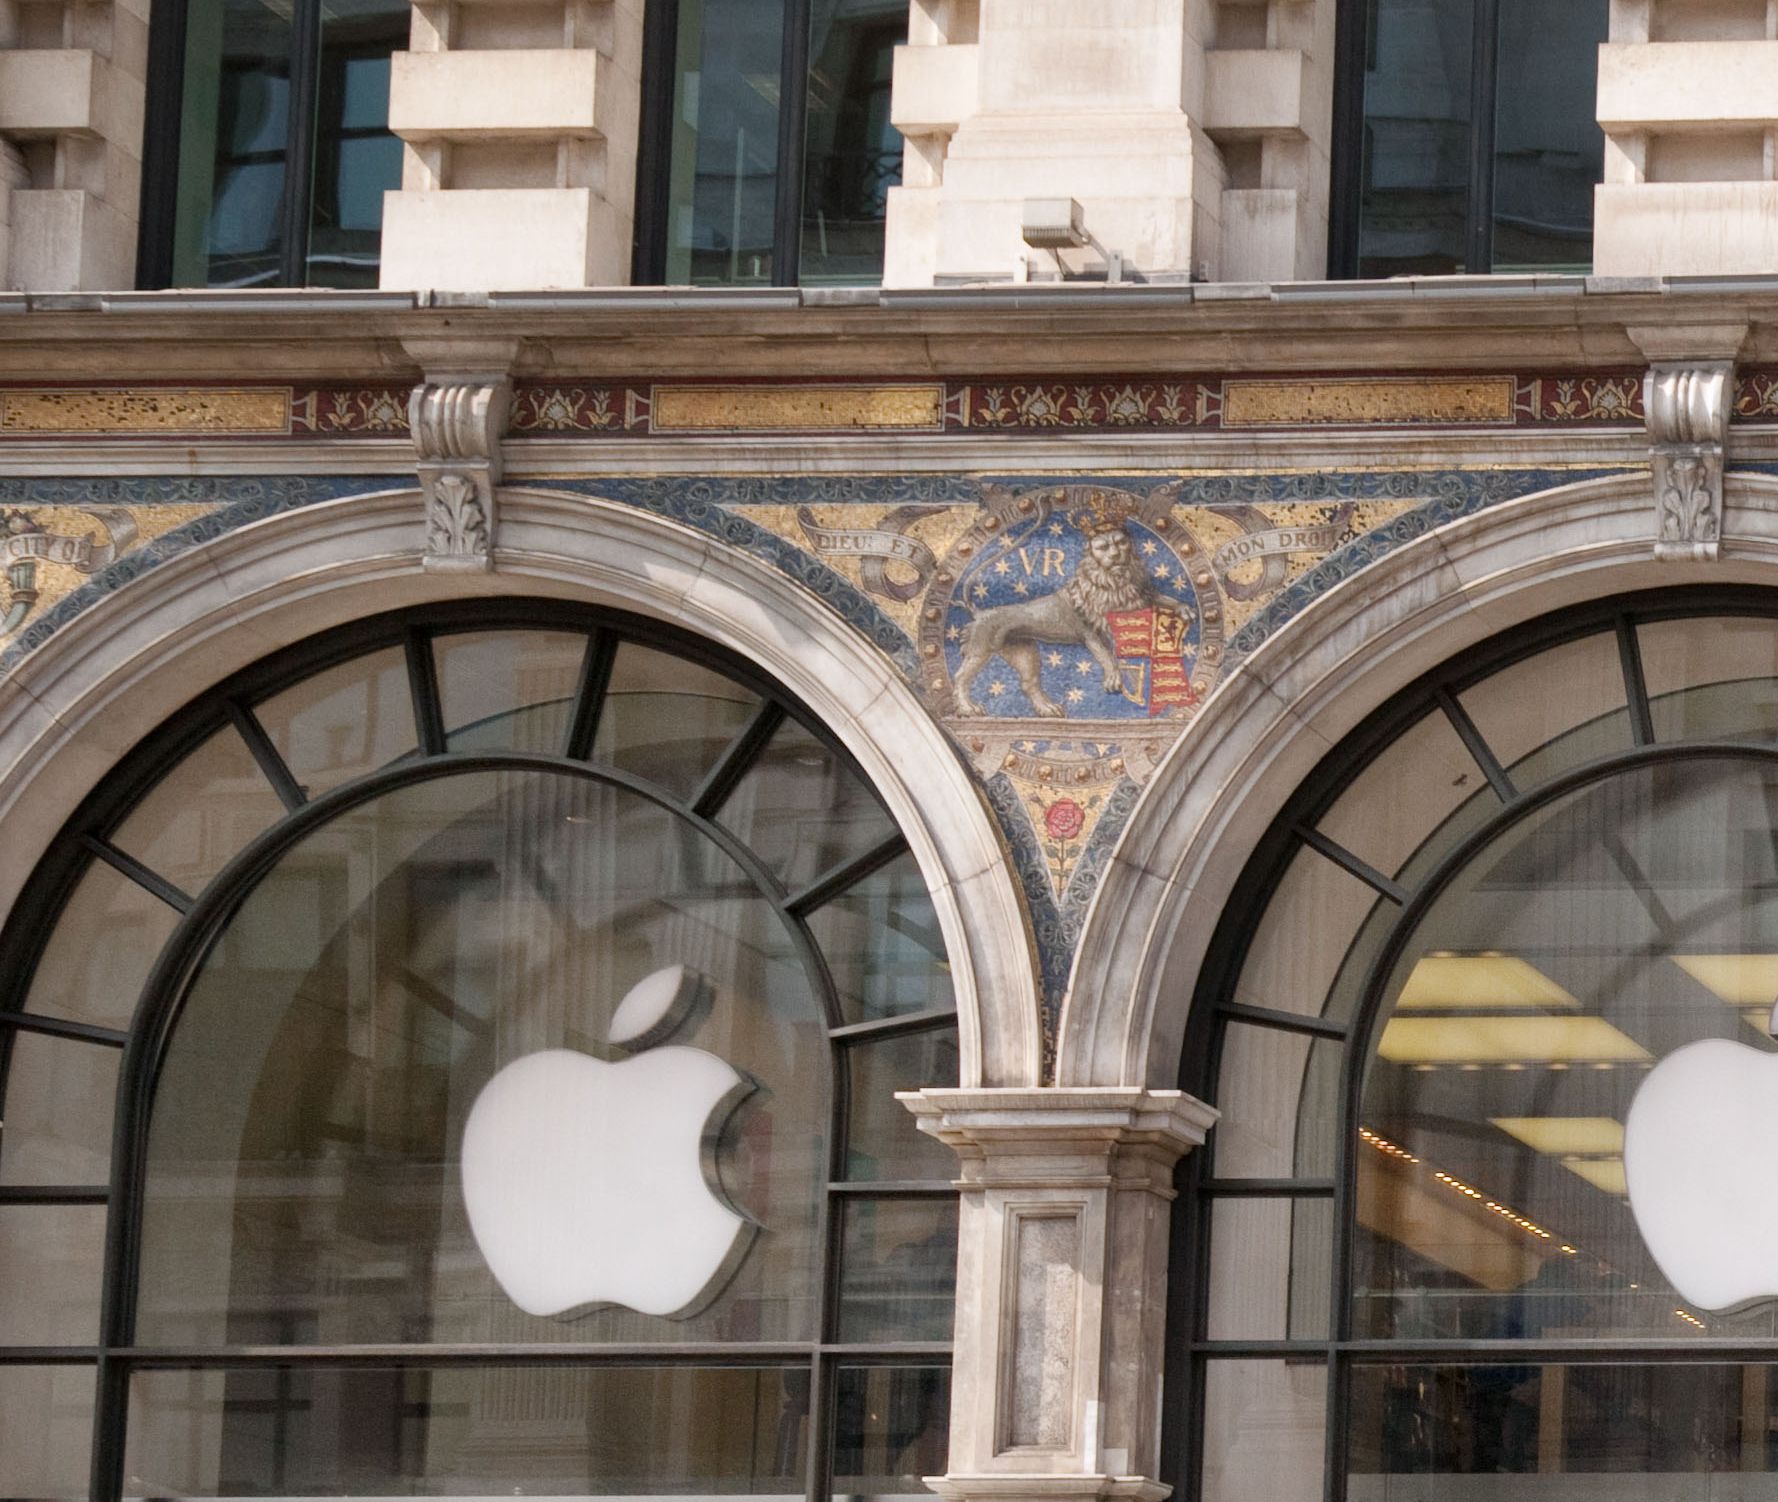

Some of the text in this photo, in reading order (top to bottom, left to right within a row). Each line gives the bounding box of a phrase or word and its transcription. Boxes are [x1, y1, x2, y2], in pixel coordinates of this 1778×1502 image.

[8, 537, 56, 557] CITY
[890, 537, 925, 560] ET
[1220, 536, 1266, 567] MON
[1018, 546, 1066, 577] VR
